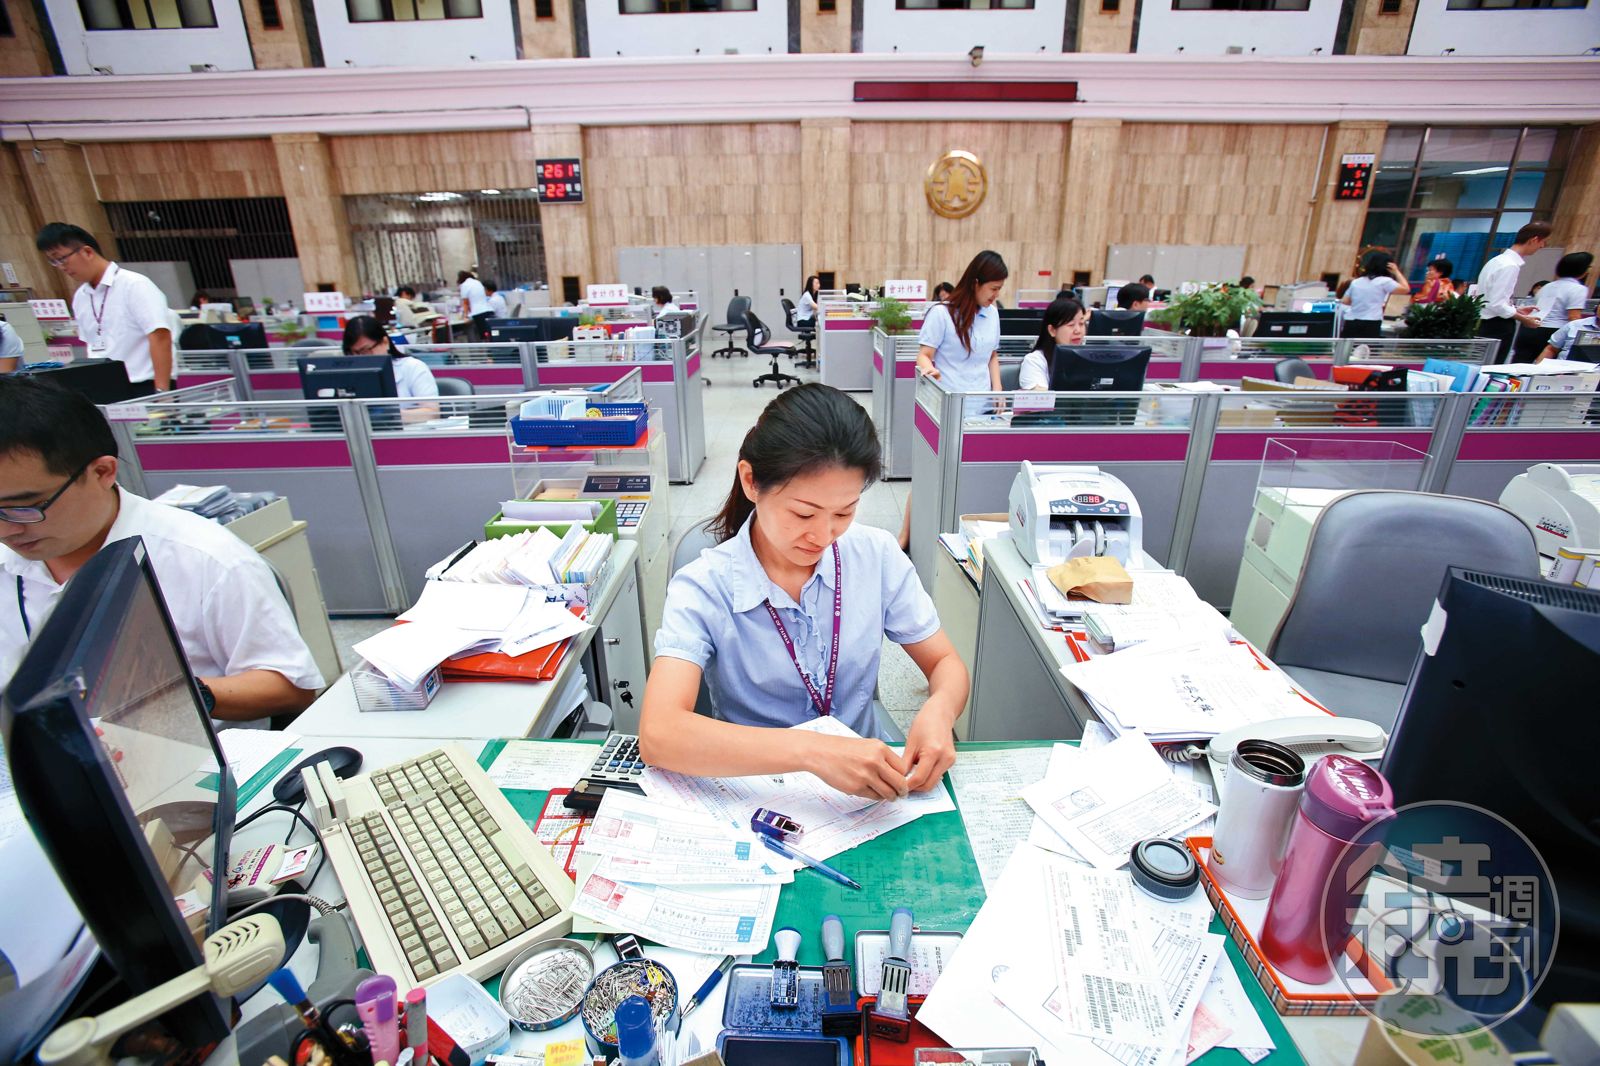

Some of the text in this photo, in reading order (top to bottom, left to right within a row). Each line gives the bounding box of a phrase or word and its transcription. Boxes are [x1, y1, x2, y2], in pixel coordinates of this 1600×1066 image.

[544, 164, 573, 178] 261
[546, 184, 566, 198] 22
[779, 627, 790, 645] TAIWAN
